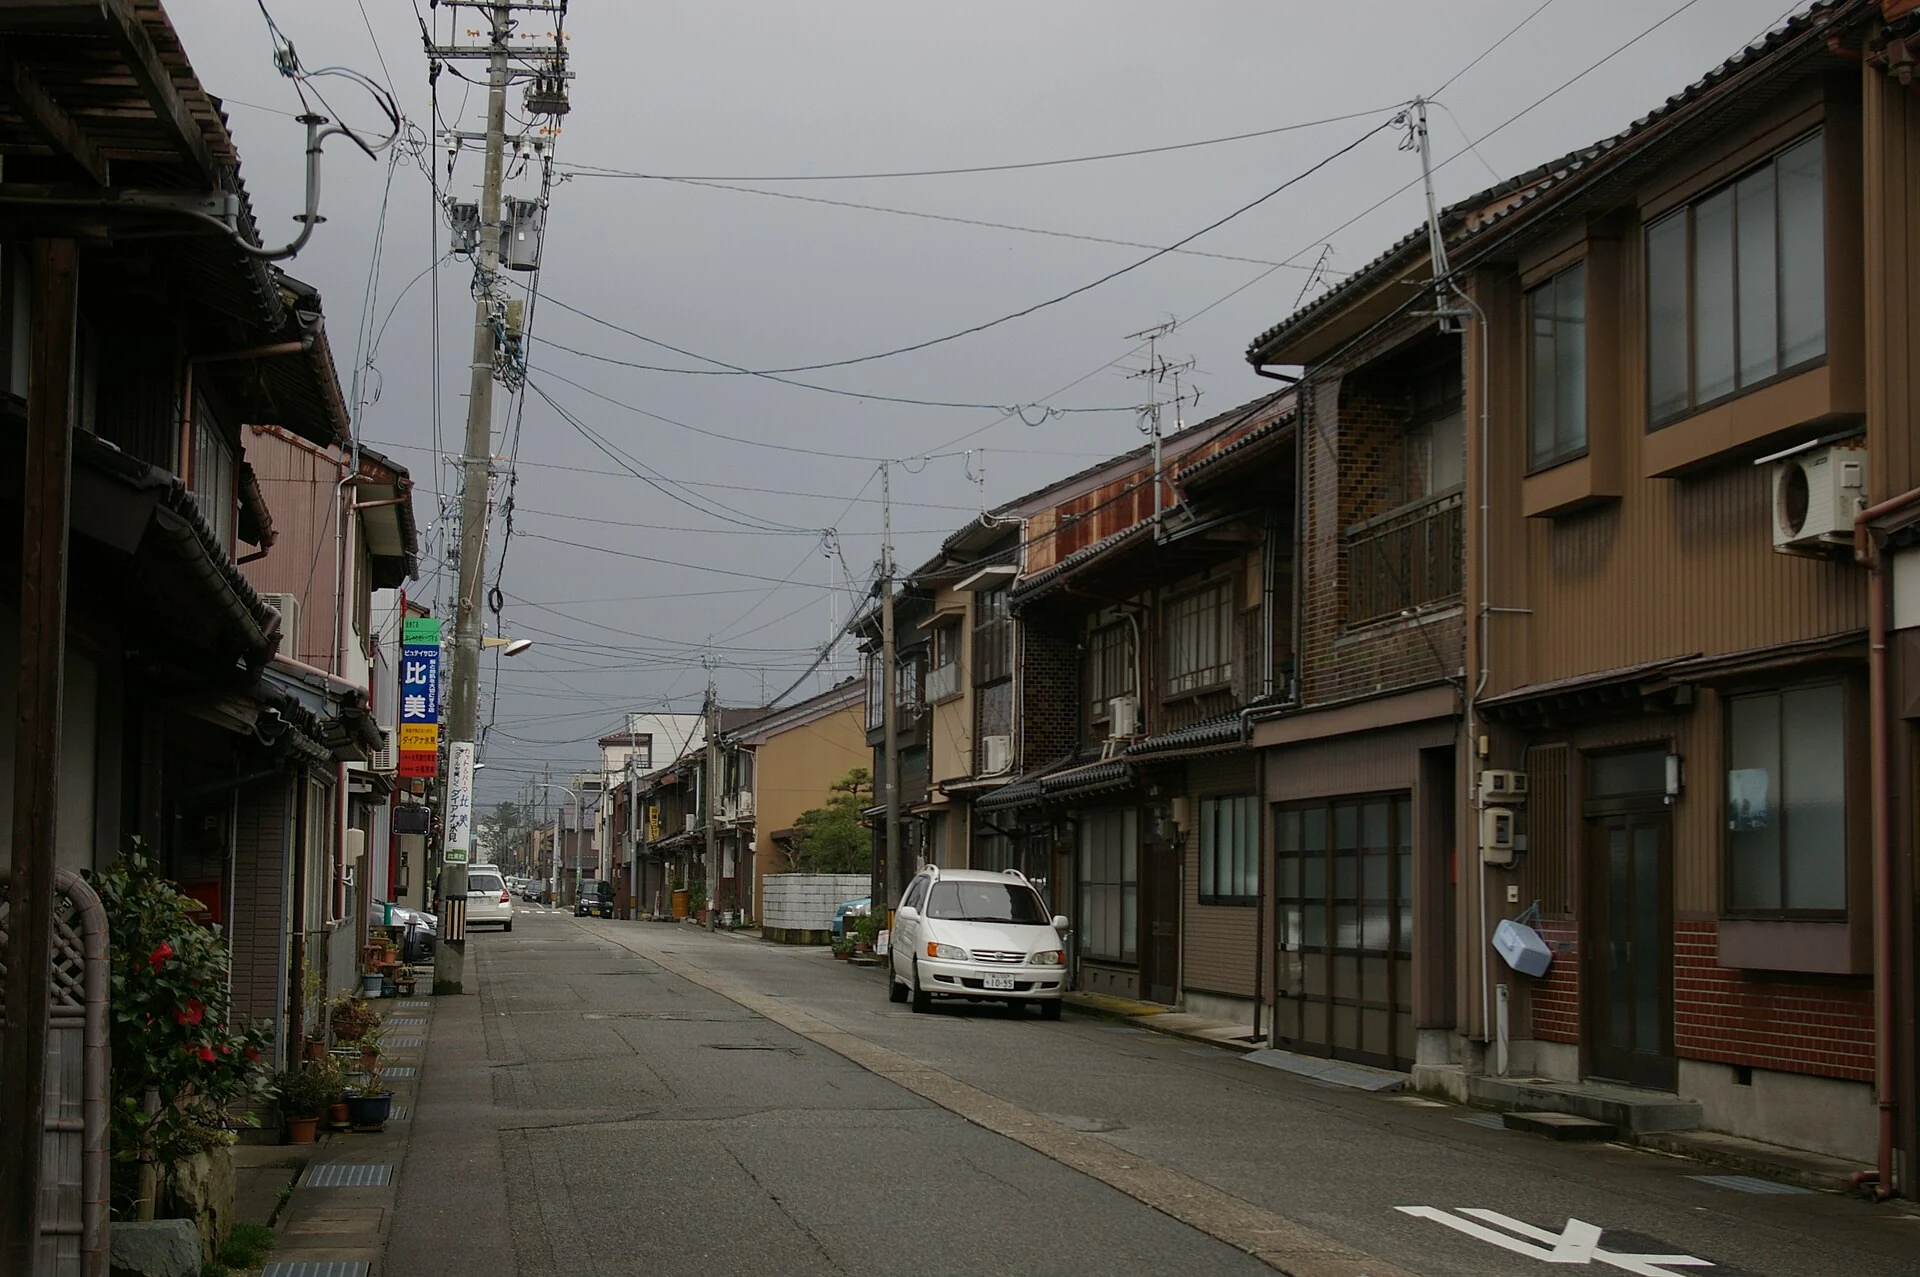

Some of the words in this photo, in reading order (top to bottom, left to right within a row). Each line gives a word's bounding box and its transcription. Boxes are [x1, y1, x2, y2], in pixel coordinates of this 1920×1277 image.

[404, 661, 427, 718] 比美
[403, 736, 435, 744] ダイアナ氷見
[449, 789, 461, 843] ダイアナ氷見
